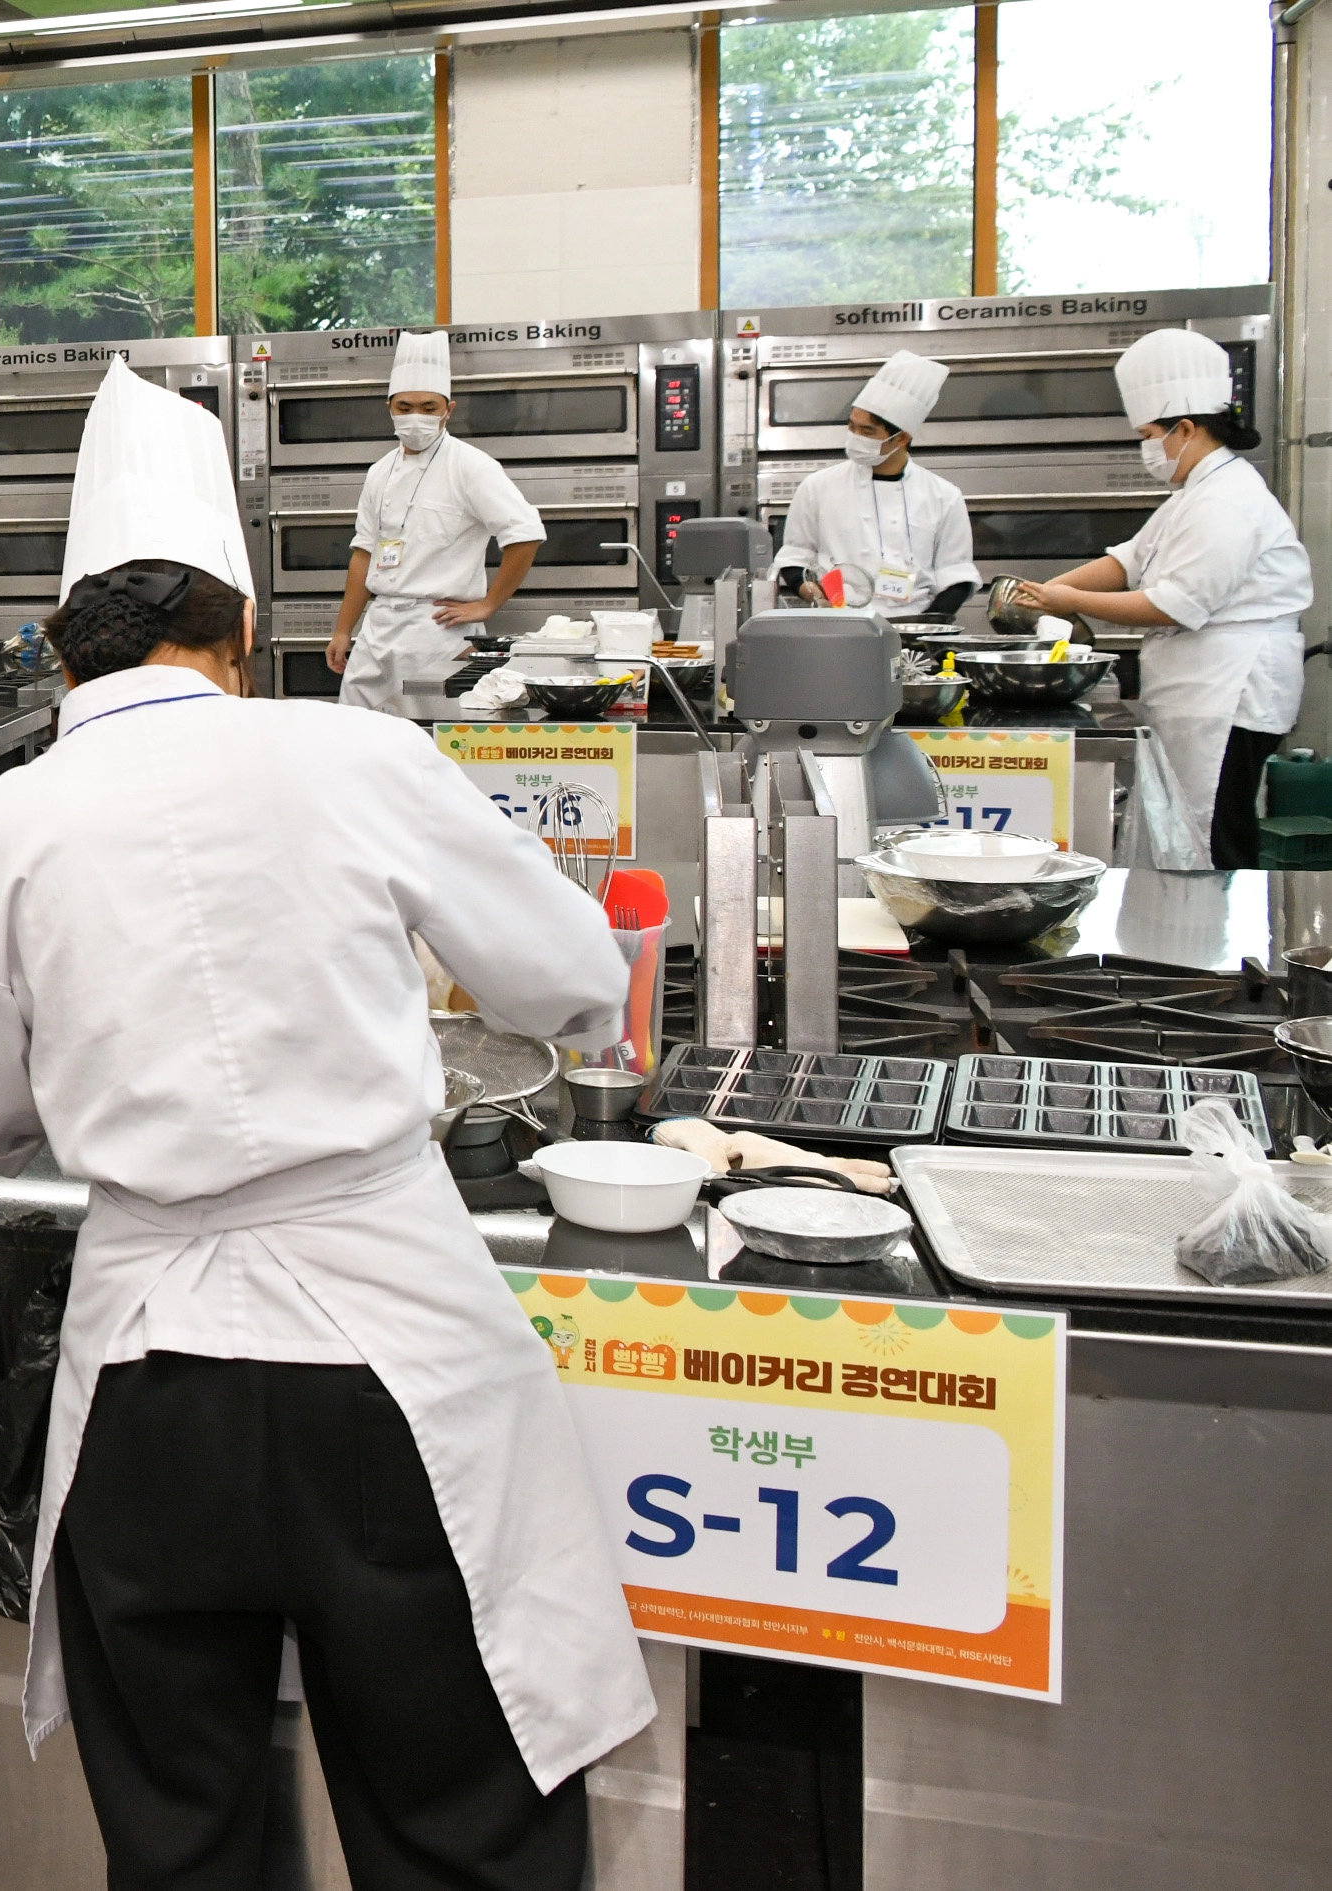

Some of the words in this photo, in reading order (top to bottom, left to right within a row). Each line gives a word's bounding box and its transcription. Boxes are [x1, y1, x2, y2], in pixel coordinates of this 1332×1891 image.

[835, 303, 923, 325] softmill
[938, 302, 1052, 321] Ceramics
[1062, 298, 1148, 315] Baking
[331, 328, 406, 349] softmil
[420, 328, 519, 345] ramics
[526, 325, 602, 339] Baking
[64, 348, 130, 363] Baking
[506, 747, 558, 759] 베이커리
[560, 747, 614, 760] 경연대회
[988, 756, 1048, 770] 경연대회
[515, 773, 553, 787] 학생부
[921, 806, 1012, 832] -17
[584, 1338, 597, 1373] 천안시
[612, 1347, 668, 1377] 빵빵
[683, 1348, 833, 1395] 베이커리
[841, 1362, 997, 1411] 경연대회
[708, 1424, 817, 1470] 학생부
[625, 1473, 899, 1586] S-12
[763, 1621, 809, 1635] 천안시지부
[854, 1633, 885, 1648] 천안시,
[959, 1649, 1013, 1667] RISE사업단
